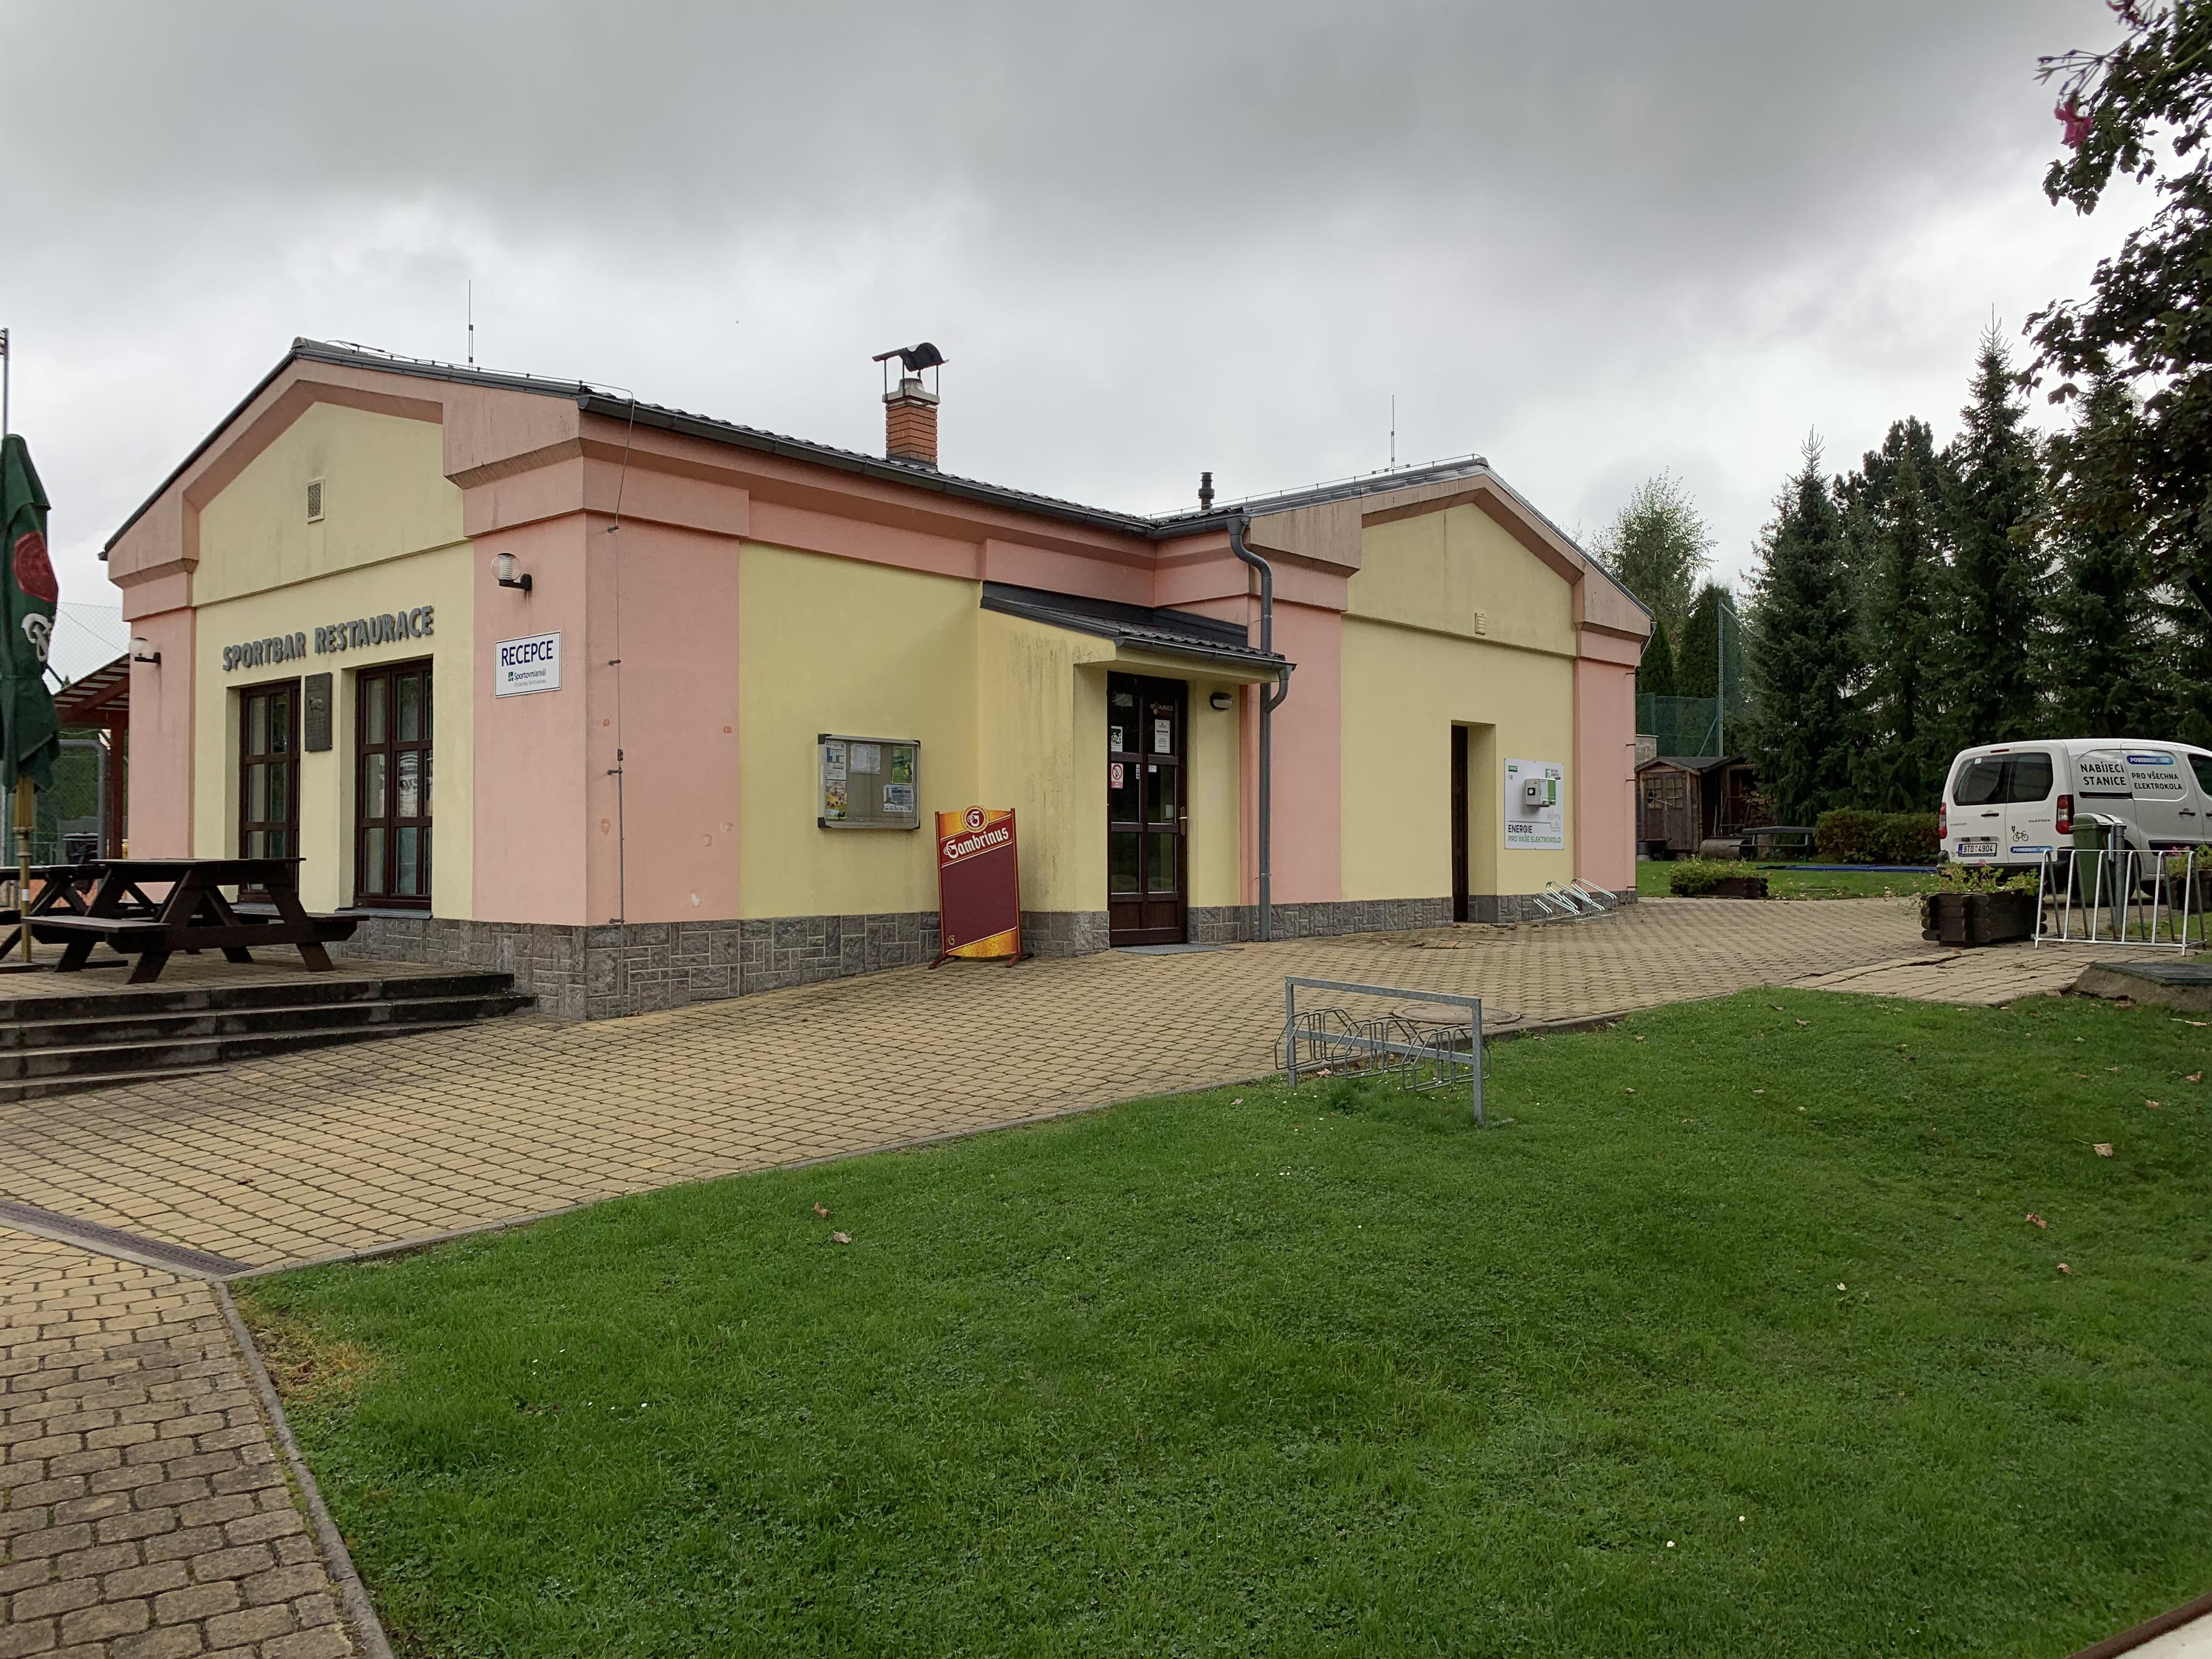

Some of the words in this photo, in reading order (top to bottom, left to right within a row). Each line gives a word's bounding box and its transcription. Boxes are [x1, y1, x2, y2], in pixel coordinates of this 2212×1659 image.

[223, 632, 306, 671] SPORTBAR
[314, 605, 434, 654] RESTAURACE
[502, 640, 554, 666] RECEPCE
[2080, 761, 2124, 773] NABÍJECÍ
[2147, 771, 2179, 780] VŠECHNA
[2083, 776, 2126, 785] STANICE
[1508, 825, 1532, 833] ENERGIE
[1519, 834, 1530, 842] VAŠE
[943, 827, 1009, 859] Gambrinus
[1978, 844, 1993, 852] 4904
